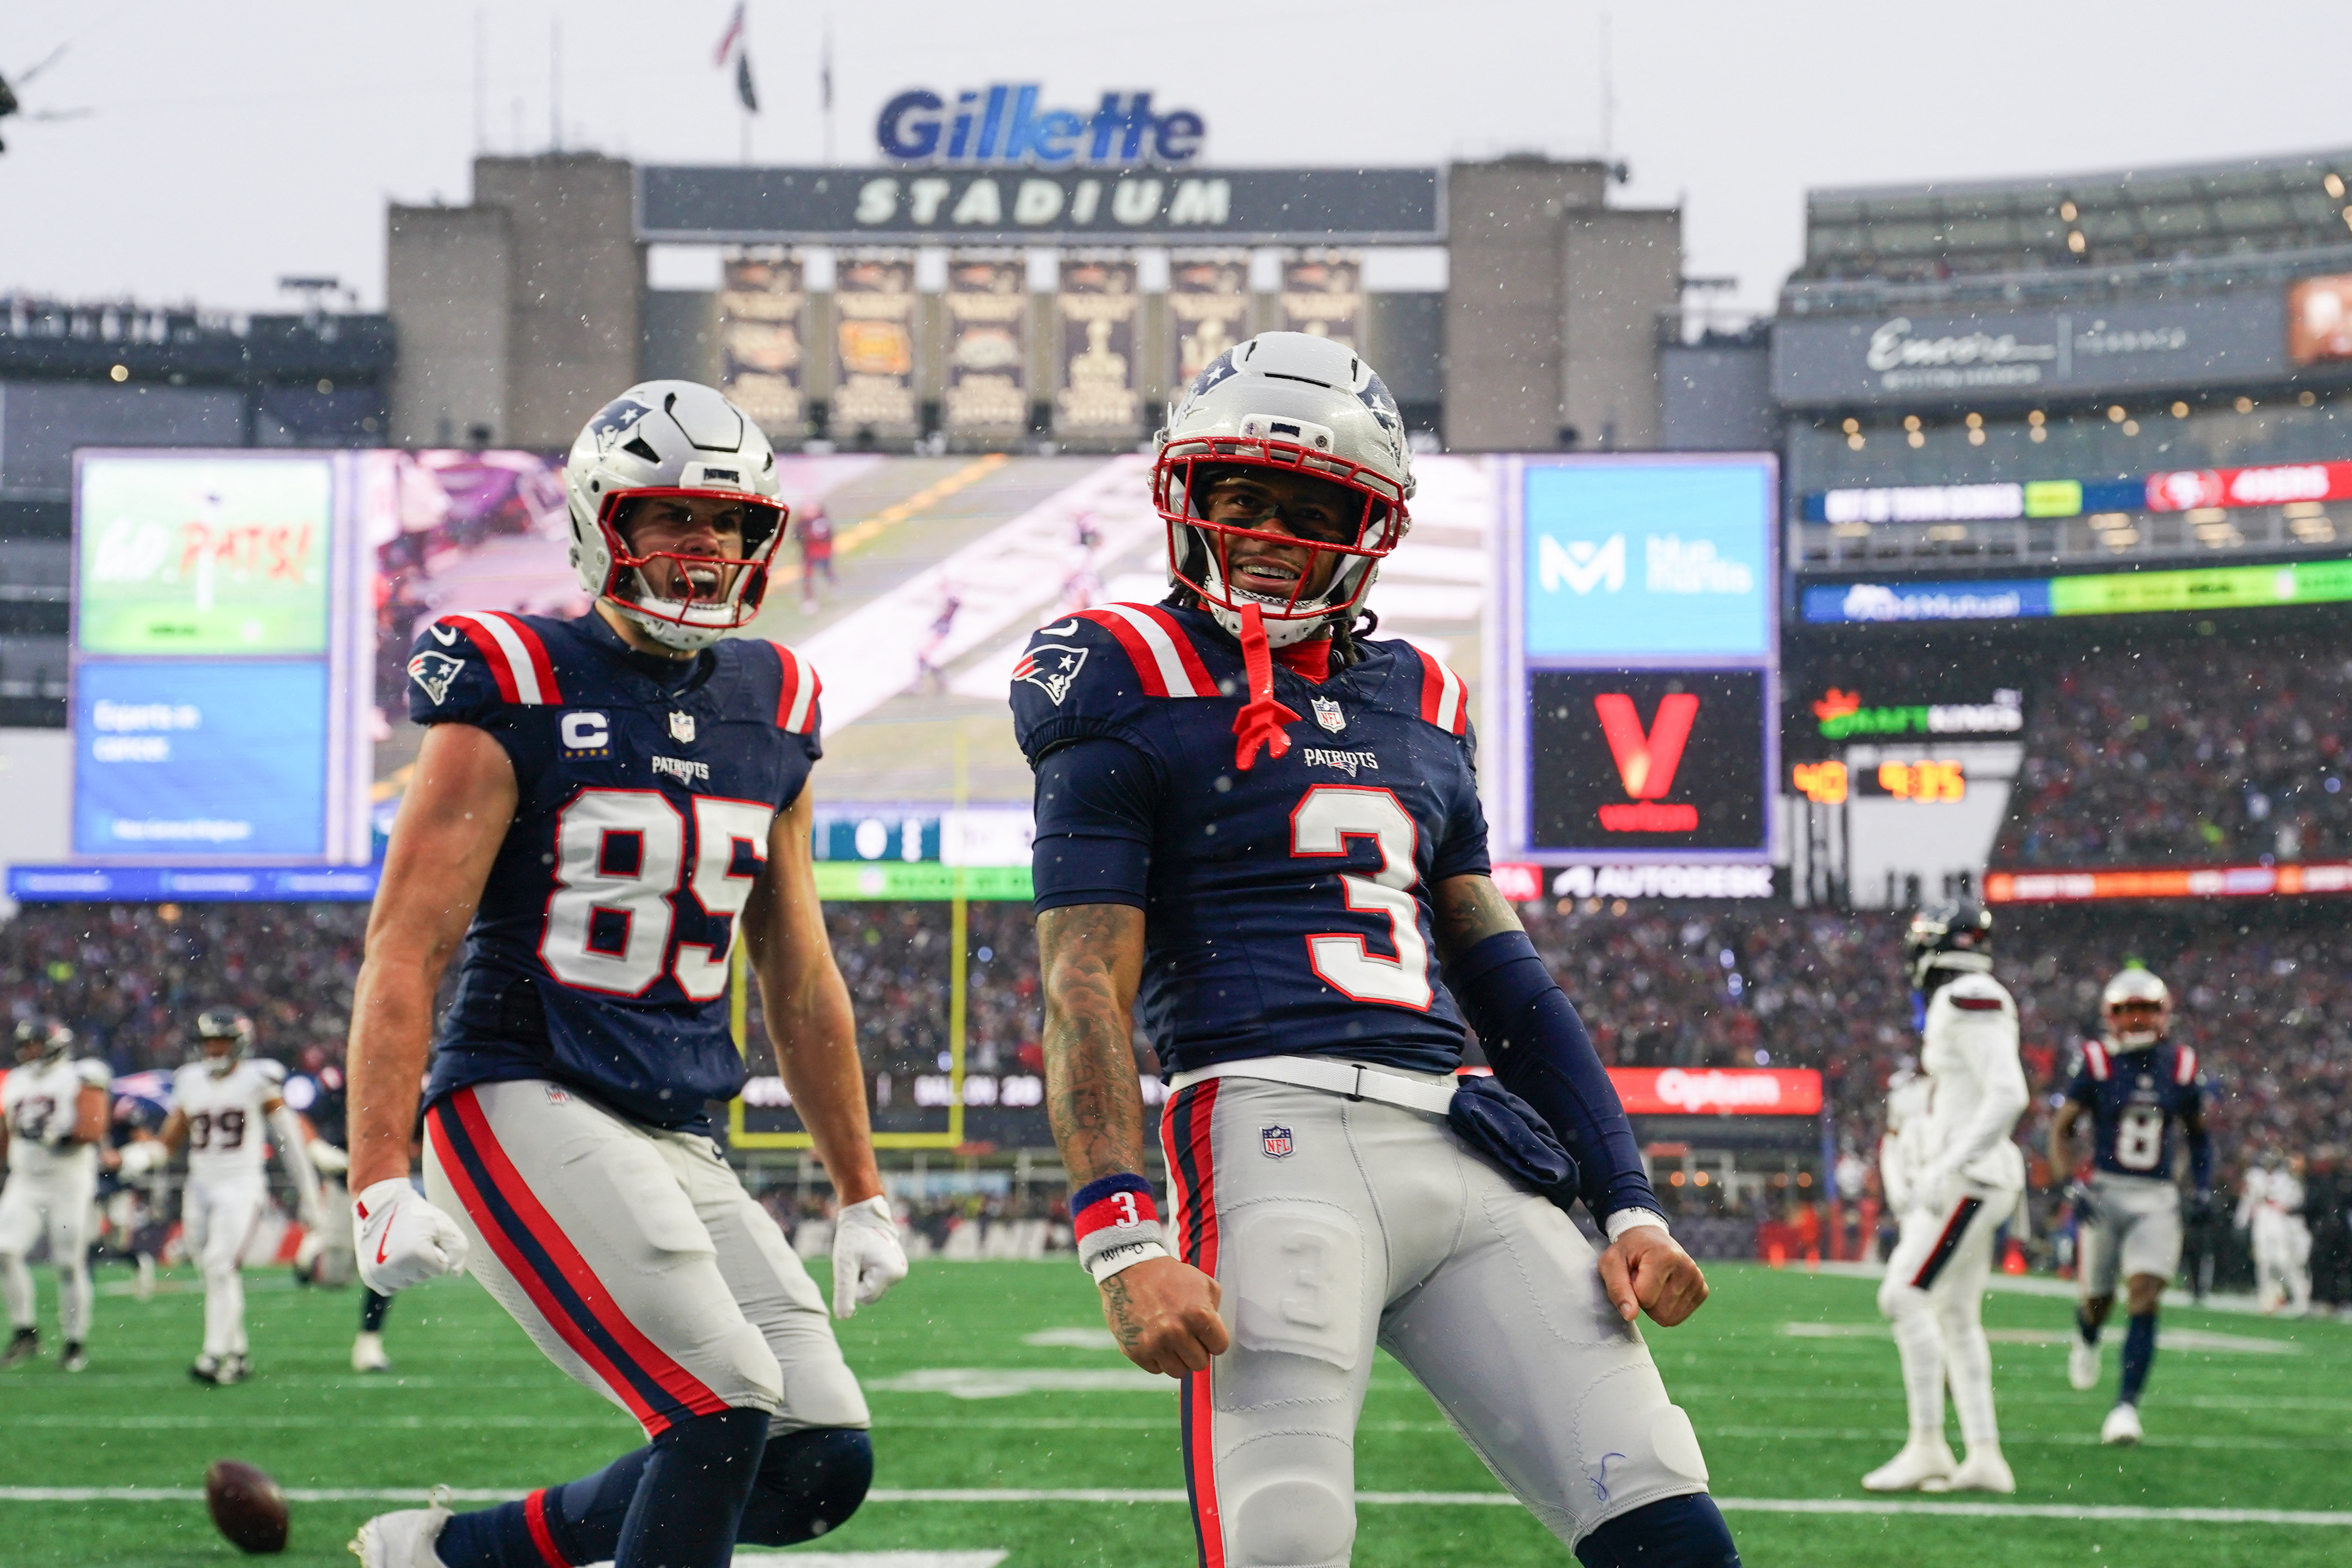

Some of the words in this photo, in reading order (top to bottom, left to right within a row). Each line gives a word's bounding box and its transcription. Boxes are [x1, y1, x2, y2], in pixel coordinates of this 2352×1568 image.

[877, 85, 1206, 160] Gillette
[855, 177, 1231, 225] STADIUM
[561, 711, 609, 750] C
[1320, 712, 1340, 727] NFL
[652, 755, 710, 781] PATRIOTS
[1303, 748, 1379, 770] PATRIOTS
[536, 787, 775, 1002] 85
[1289, 783, 1434, 1013] 3
[1595, 864, 1775, 899] AUTODESK
[1654, 1067, 1781, 1112] Optum
[1266, 1139, 1290, 1154] NFL
[2114, 1104, 2166, 1170] 8
[1111, 1191, 1140, 1228] 3
